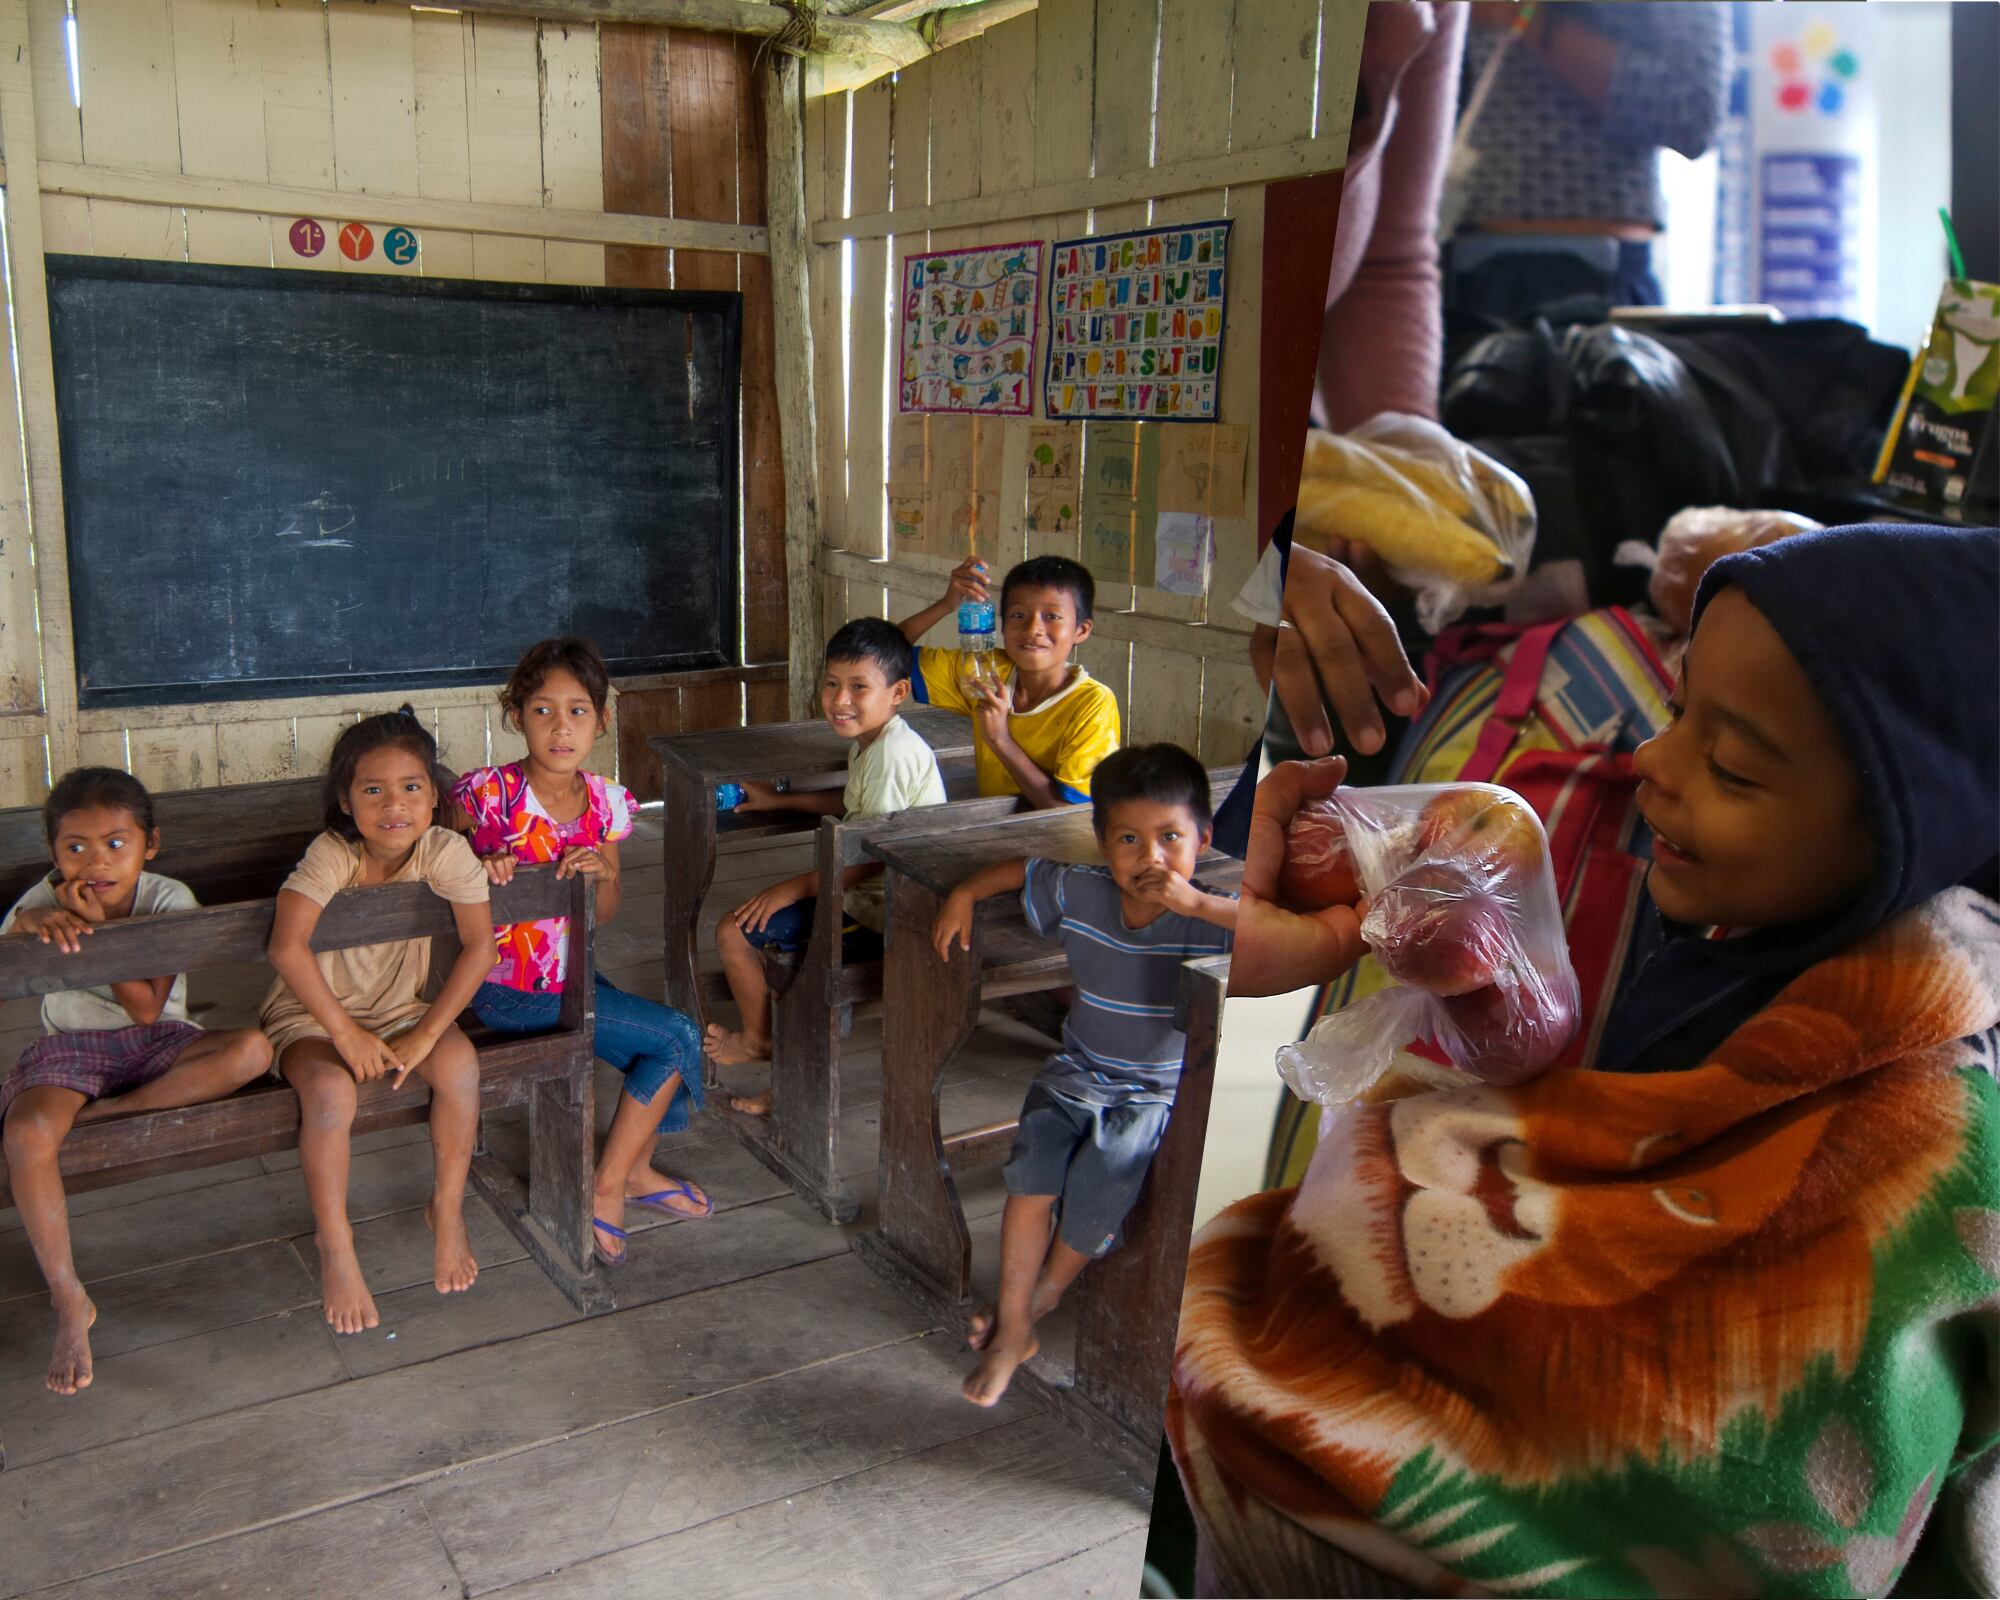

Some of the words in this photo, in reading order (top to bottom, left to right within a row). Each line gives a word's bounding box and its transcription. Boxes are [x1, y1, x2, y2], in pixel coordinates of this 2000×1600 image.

[345, 227, 366, 259] Y
[1067, 248, 1078, 273] A
[1095, 245, 1106, 271] B
[1120, 240, 1134, 268] C
[1178, 233, 1193, 261] D
[1213, 229, 1225, 257] E
[1066, 283, 1078, 309] F
[1175, 271, 1190, 299] J
[1207, 268, 1223, 297] K
[1065, 318, 1075, 343] L
[1144, 311, 1158, 338] N
[1205, 308, 1221, 336] O
[1066, 352, 1075, 377] P
[1140, 348, 1155, 376] S
[1171, 347, 1184, 374] T
[1202, 346, 1217, 374] U
[1012, 378, 1025, 407] 1
[1138, 384, 1153, 411] Y
[1169, 384, 1181, 411] Z
